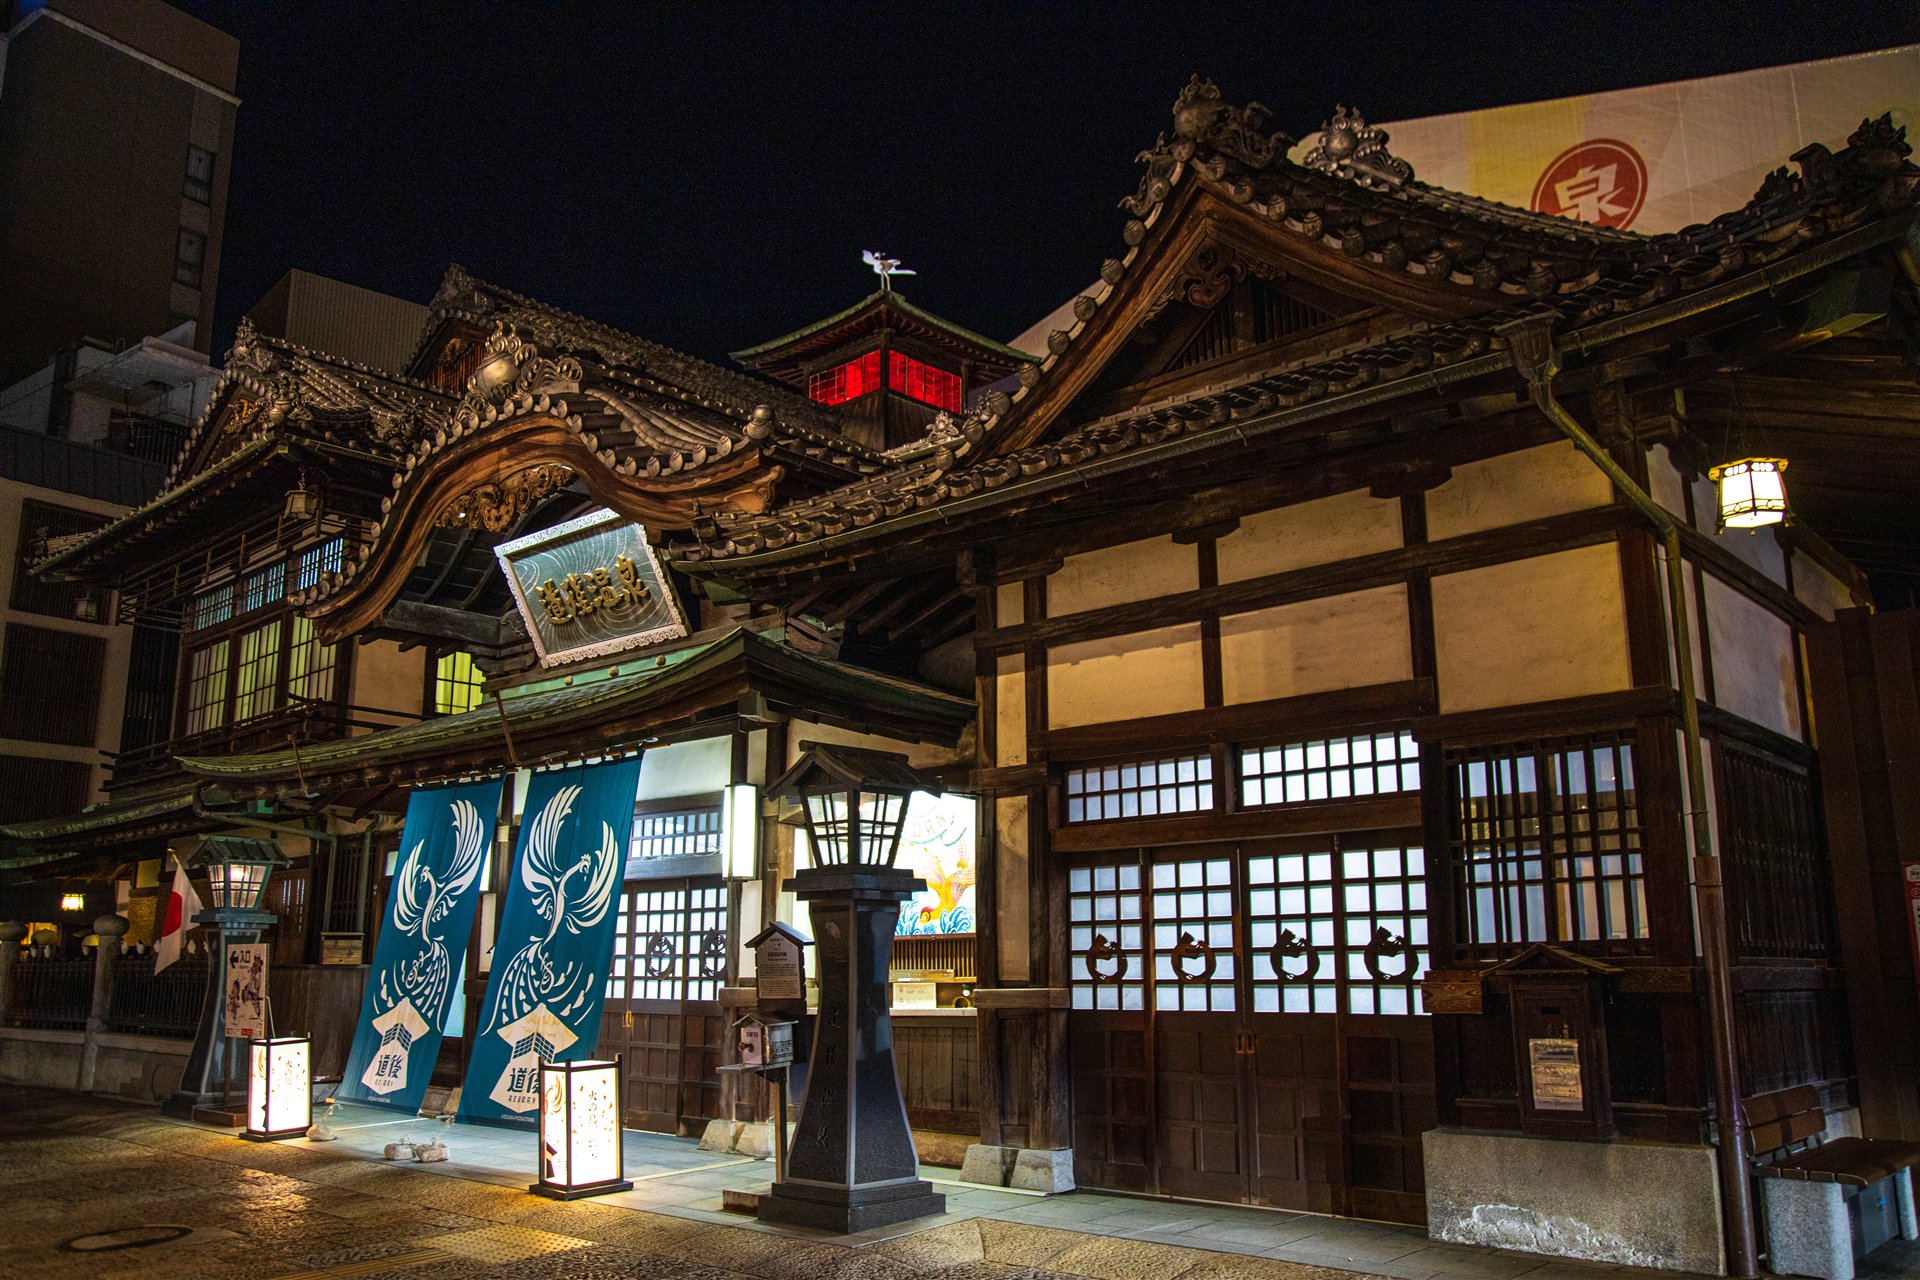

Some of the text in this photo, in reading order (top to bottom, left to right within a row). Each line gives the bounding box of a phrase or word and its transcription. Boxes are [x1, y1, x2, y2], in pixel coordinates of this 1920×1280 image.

[535, 554, 650, 625] 道後温泉
[239, 950, 251, 963] 入口
[375, 1054, 404, 1078] 道後
[506, 1067, 540, 1094] 道後
[508, 1095, 536, 1104] REBORN
